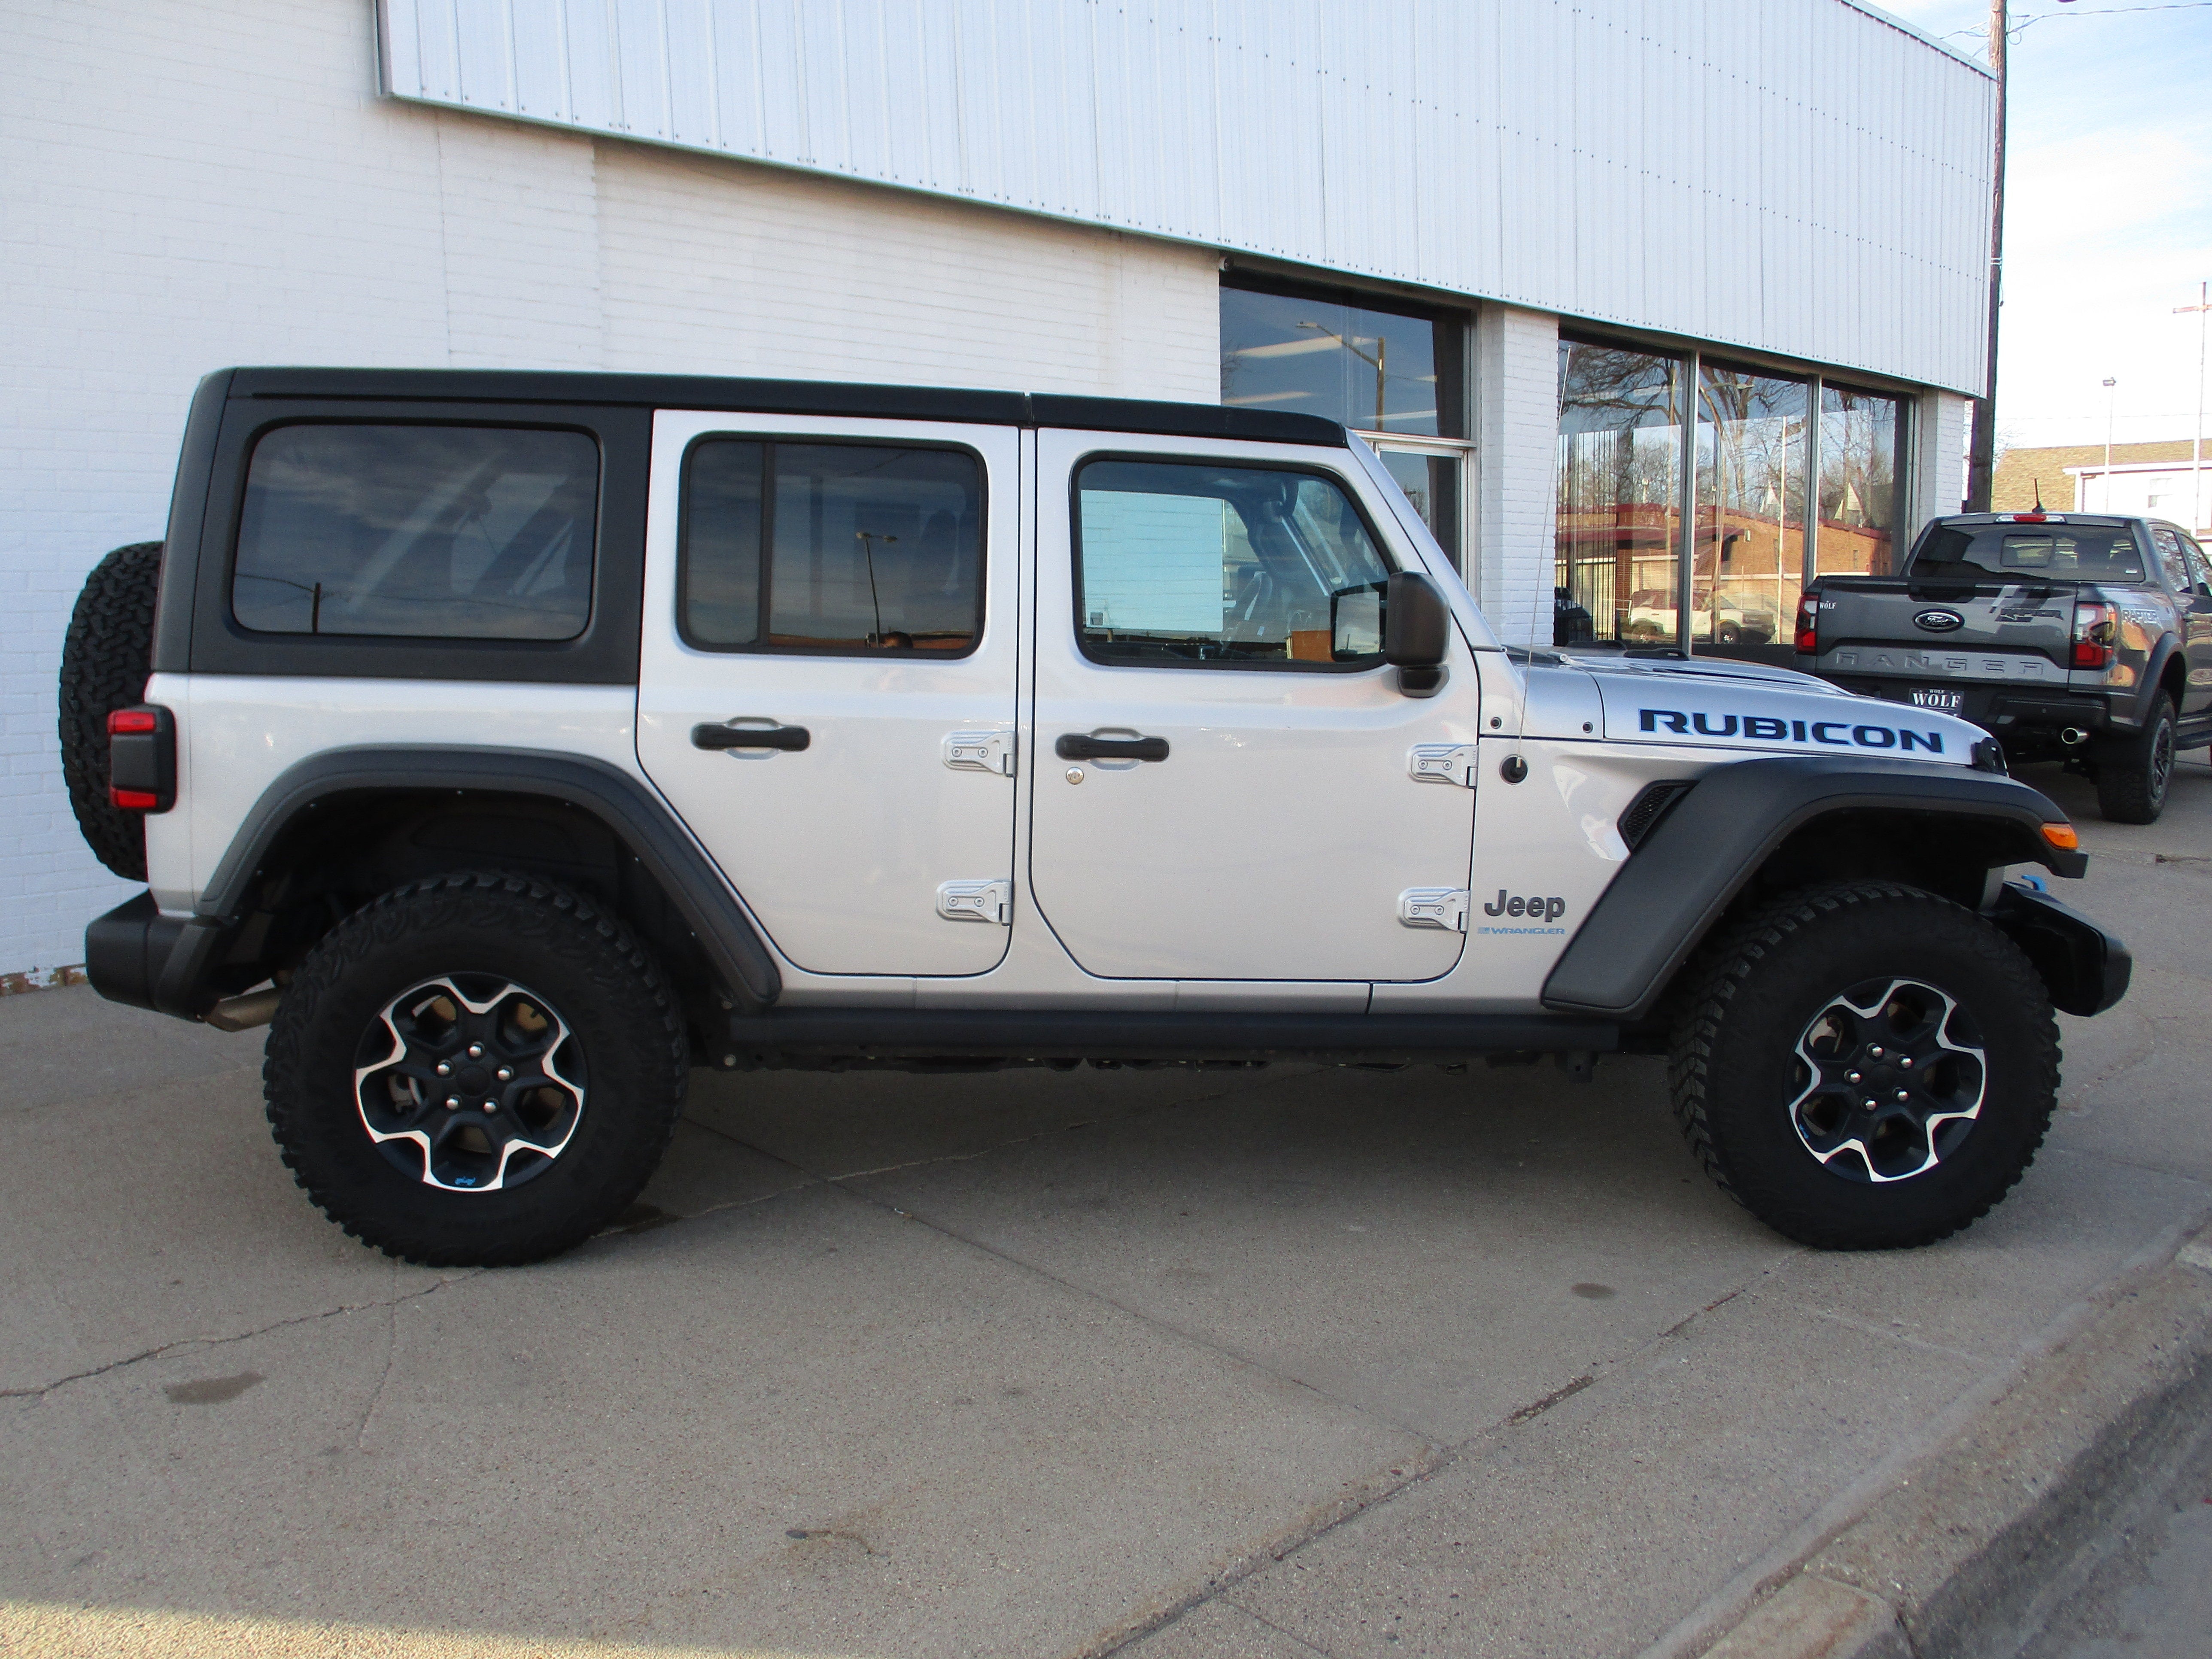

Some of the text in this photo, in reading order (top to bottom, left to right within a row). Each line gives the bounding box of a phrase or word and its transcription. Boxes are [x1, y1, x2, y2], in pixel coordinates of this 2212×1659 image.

[1819, 601, 1836, 609] WOLF
[1924, 616, 1949, 626] Ford
[1835, 652, 2044, 675] RANGER
[1912, 693, 1961, 708] WOLF
[1638, 708, 1945, 754] RUBICON
[1484, 889, 1566, 923] Jeep
[1490, 927, 1565, 935] WRANGLER
